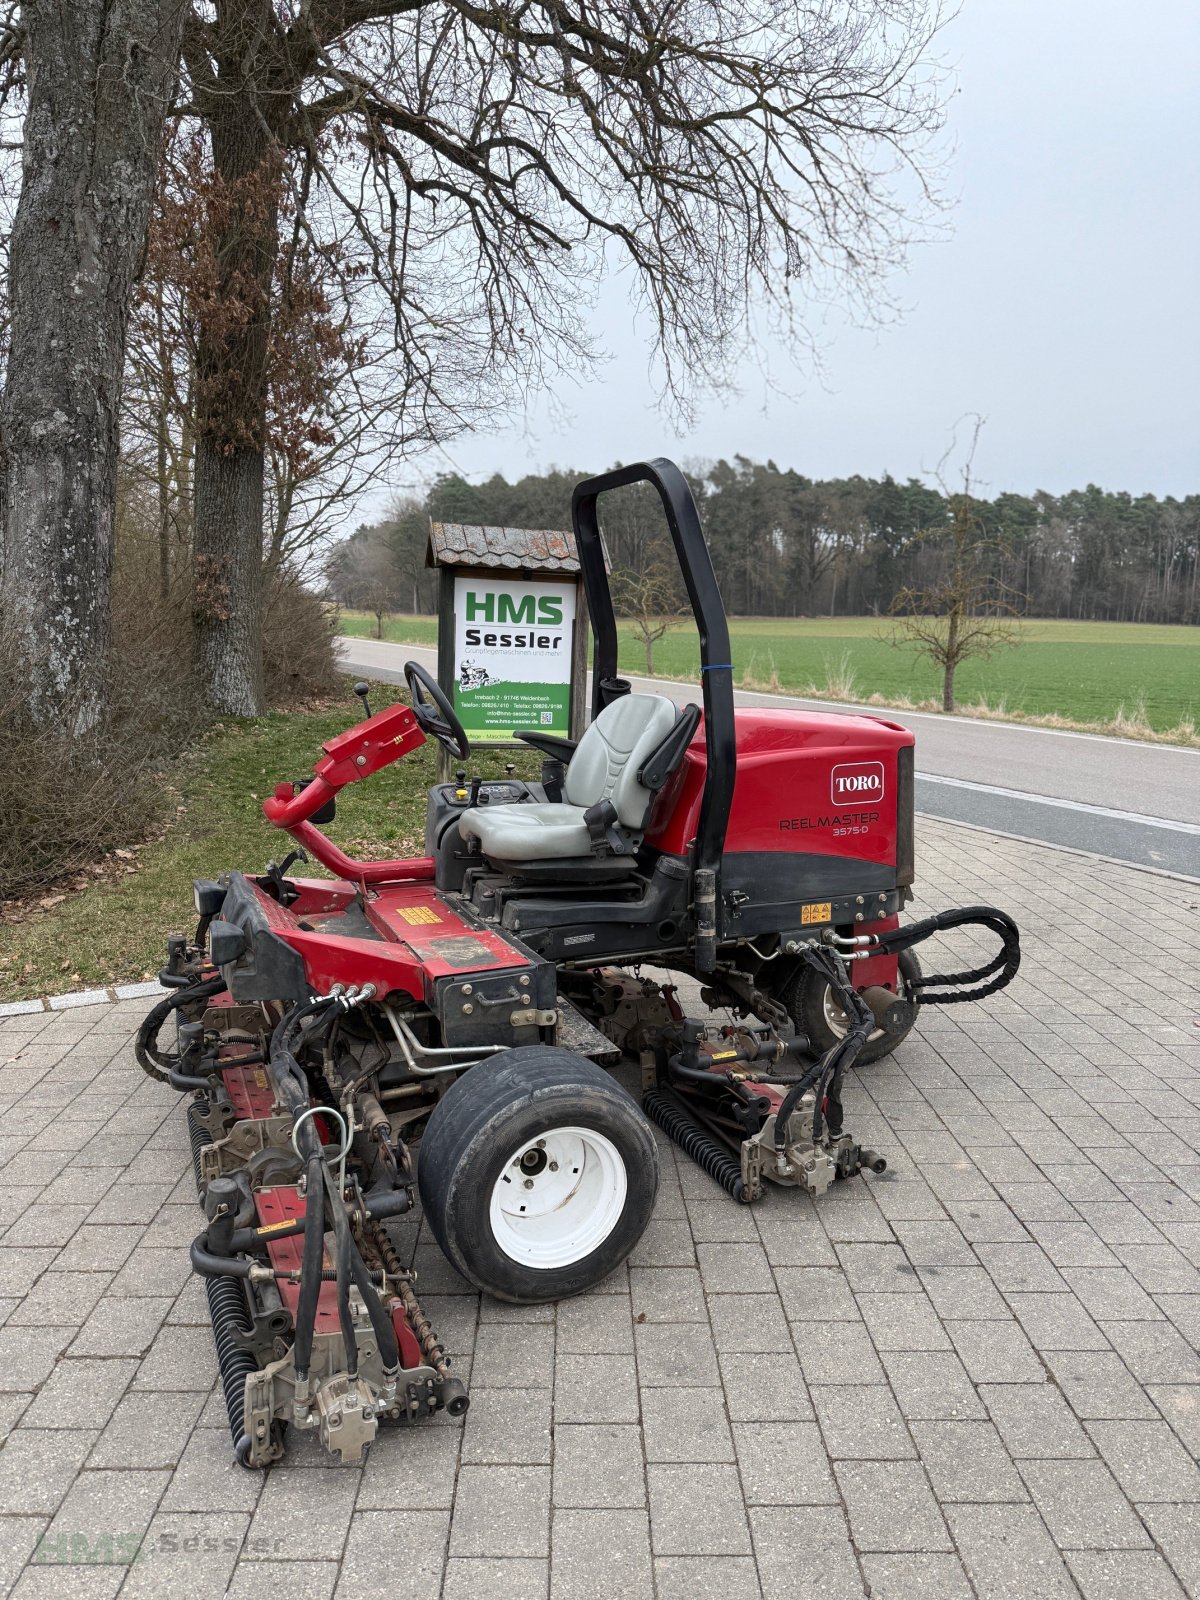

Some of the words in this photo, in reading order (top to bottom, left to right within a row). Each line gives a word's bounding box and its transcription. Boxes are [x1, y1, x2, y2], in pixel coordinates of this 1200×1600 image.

[466, 591, 563, 625] HMS
[465, 629, 562, 649] Sessler
[836, 774, 879, 792] TORO
[779, 812, 880, 831] REELMASTER
